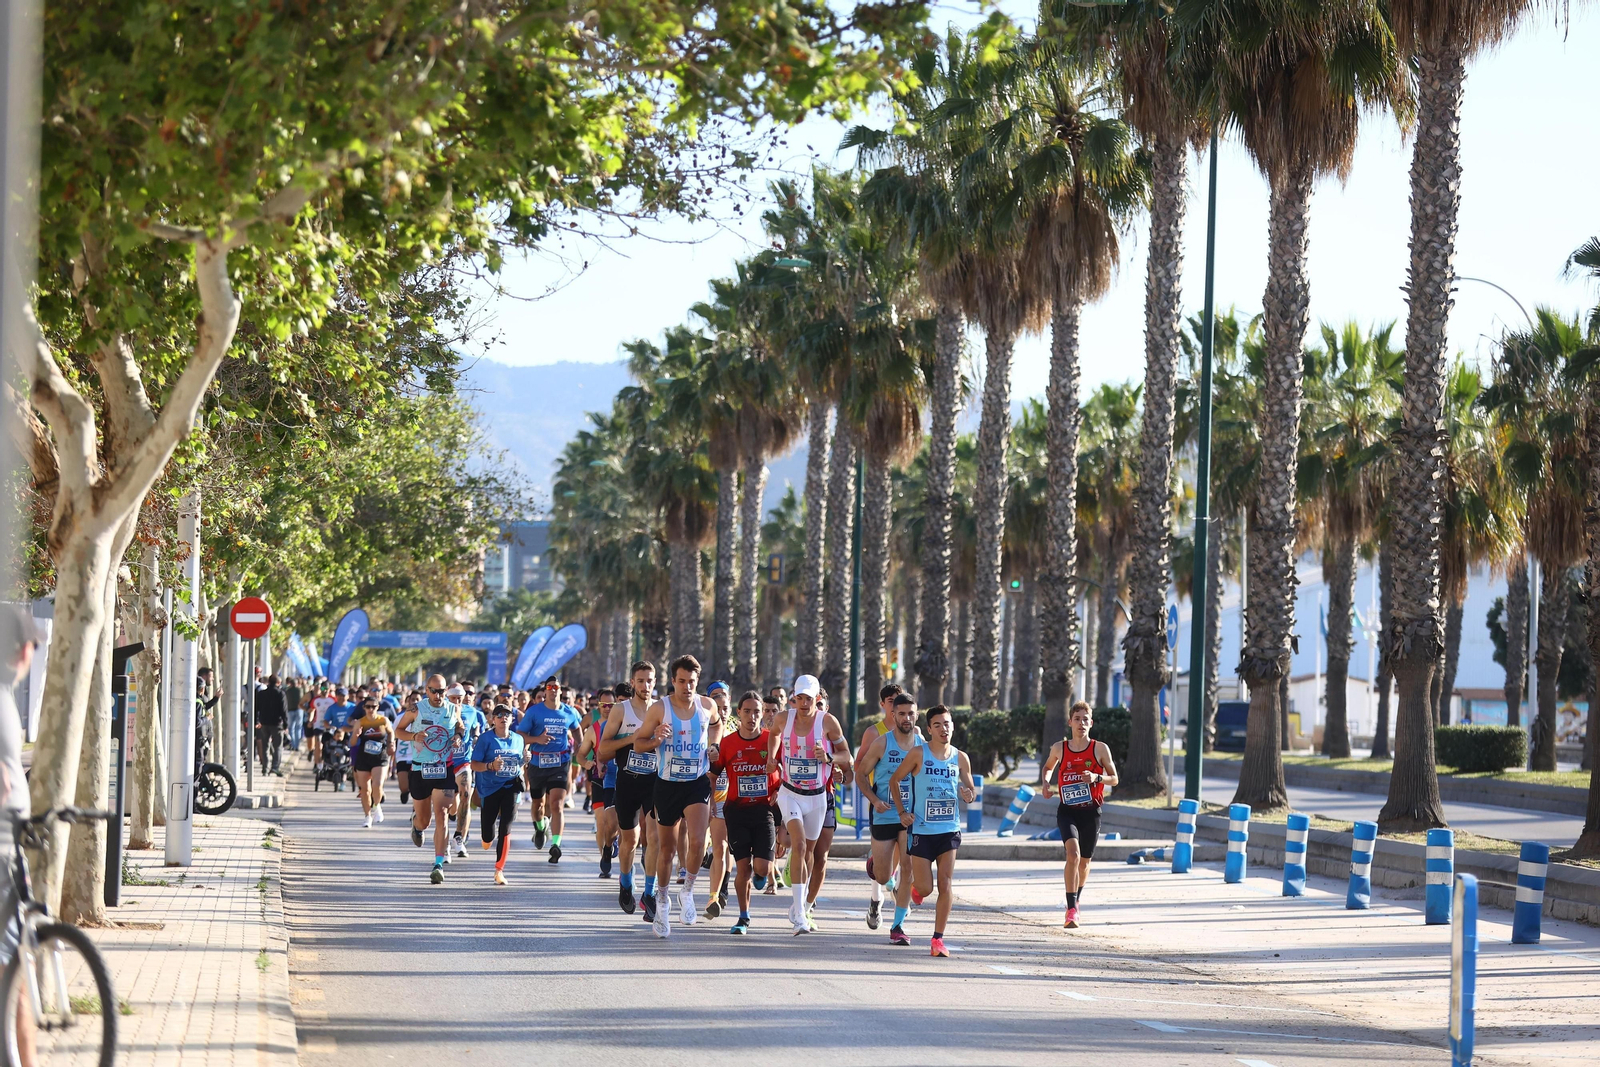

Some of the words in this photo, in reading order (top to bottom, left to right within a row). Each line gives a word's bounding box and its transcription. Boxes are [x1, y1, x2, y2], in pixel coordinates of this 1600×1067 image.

[333, 621, 361, 668] mayoral
[461, 635, 501, 646] mayoral
[534, 634, 577, 678] mayoral
[631, 758, 654, 769] 1992
[733, 764, 767, 772] CARTAM
[925, 766, 956, 779] nerja
[741, 783, 764, 791] 1681
[1065, 790, 1088, 799] 2149
[929, 807, 953, 815] 2156
